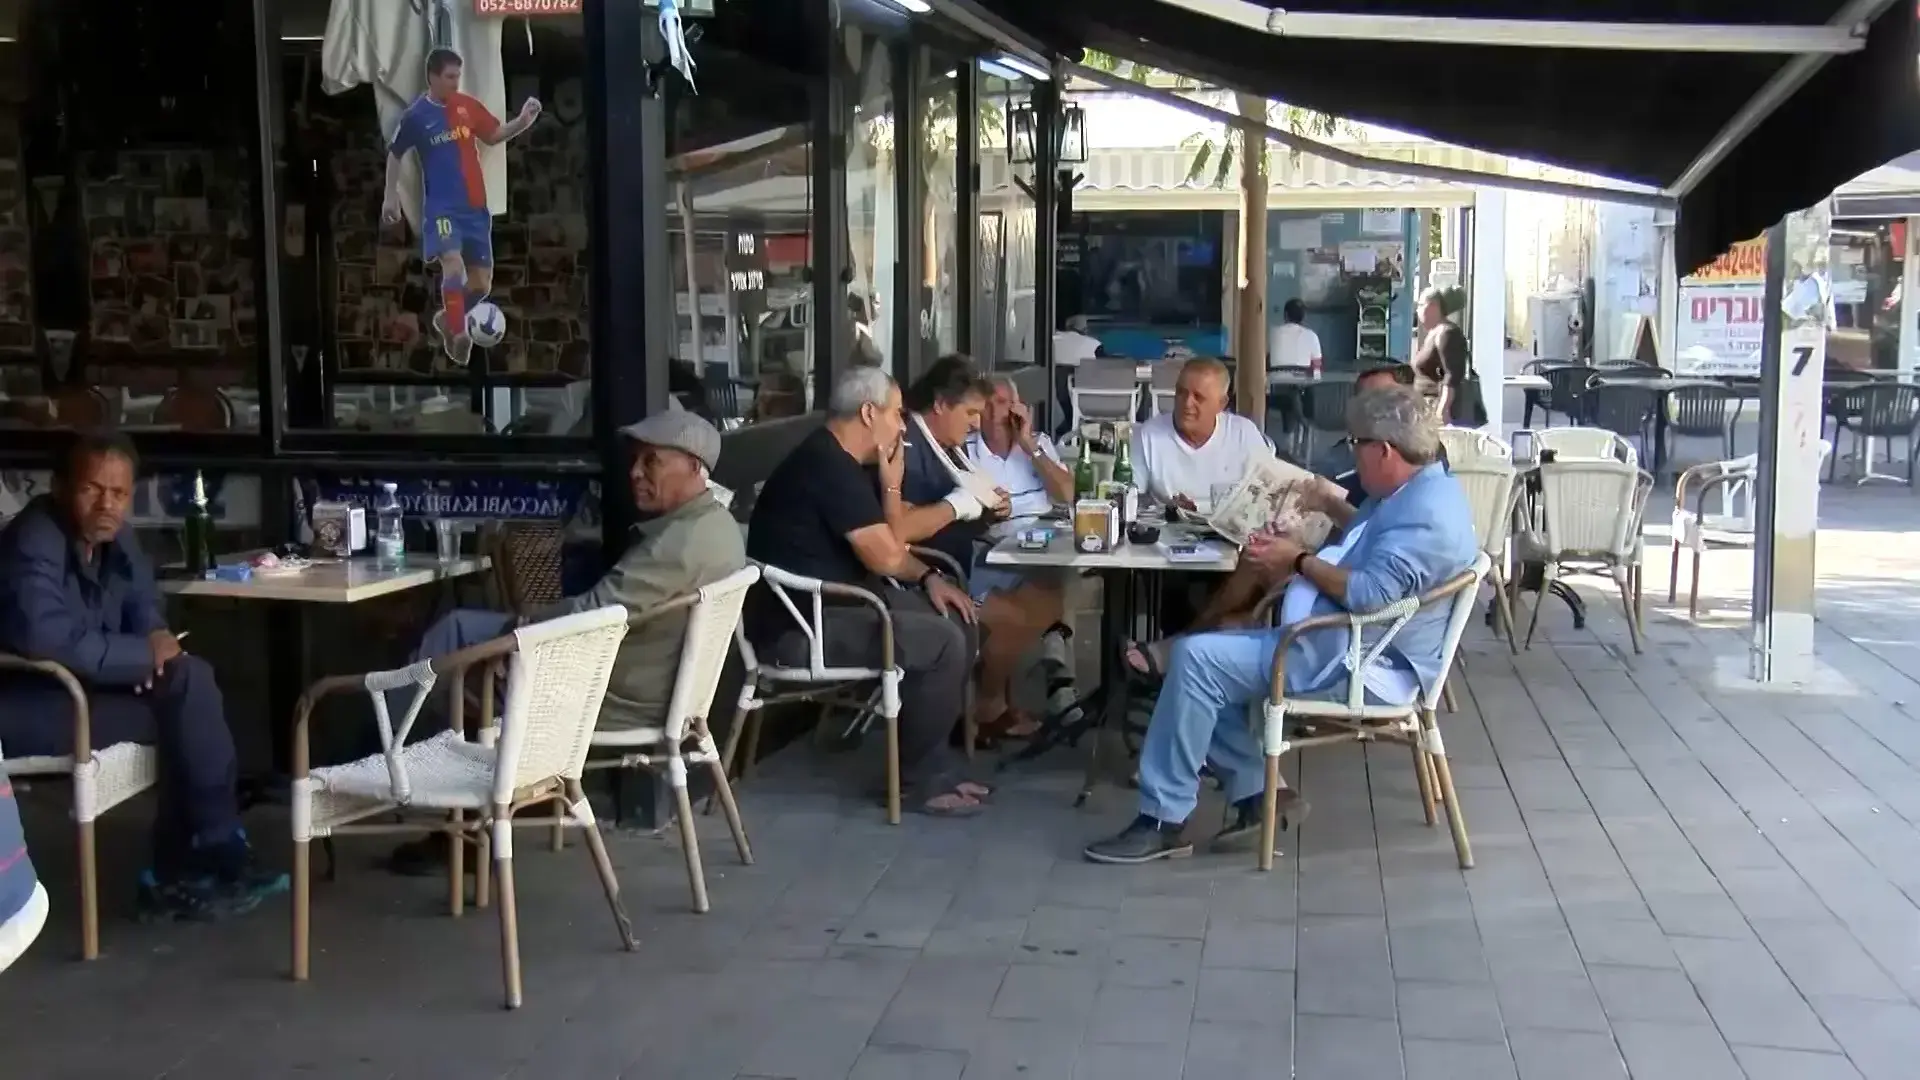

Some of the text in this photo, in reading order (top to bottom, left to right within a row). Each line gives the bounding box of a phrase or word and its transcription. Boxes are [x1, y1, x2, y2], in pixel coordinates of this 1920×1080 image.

[436, 217, 452, 238] 10
[1691, 297, 1764, 324] וברים
[1791, 346, 1815, 377] 7
